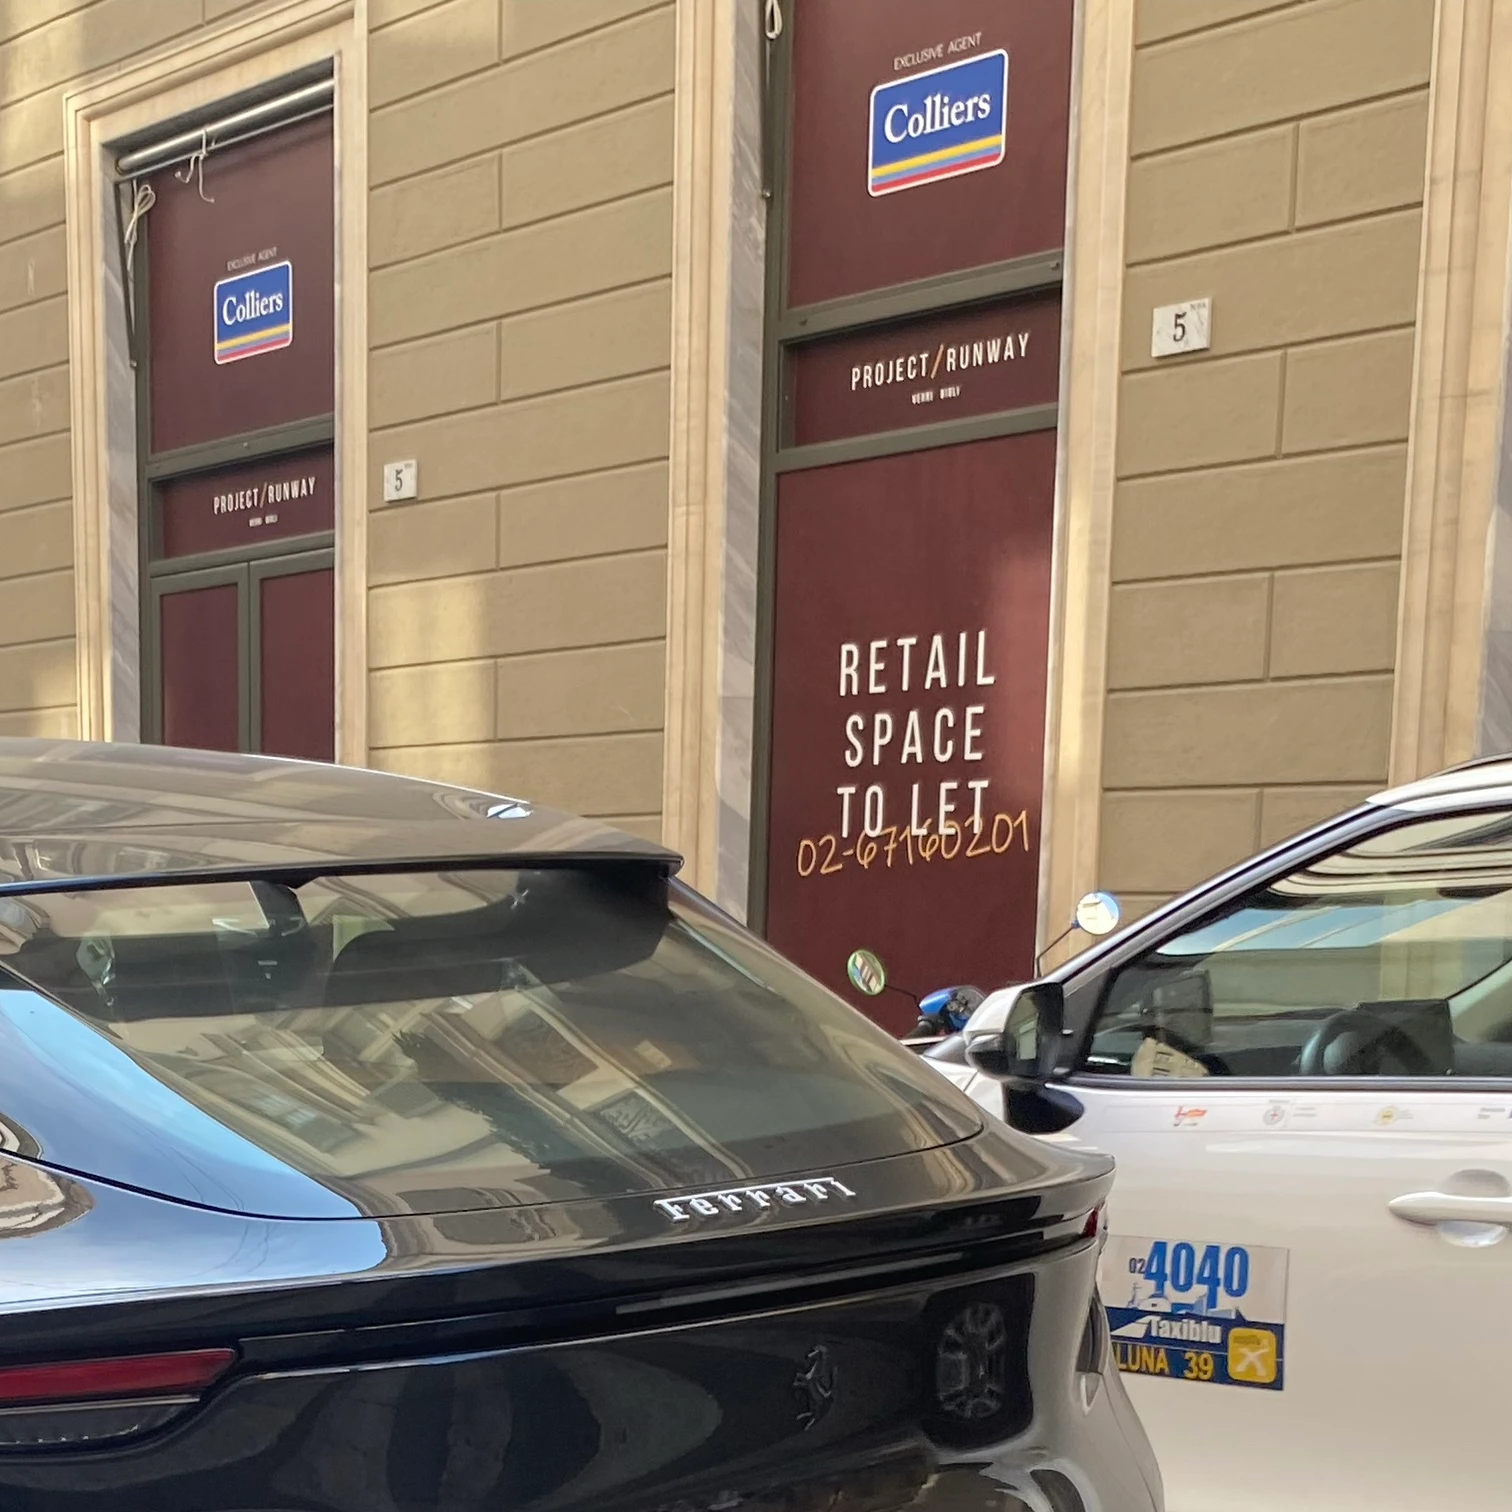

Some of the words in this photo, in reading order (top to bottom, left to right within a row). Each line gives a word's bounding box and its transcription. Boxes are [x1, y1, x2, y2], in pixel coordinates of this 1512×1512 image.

[894, 44, 943, 70] EXCLUSIVE
[948, 32, 982, 54] AGENT
[884, 93, 991, 143] Colliers
[222, 289, 284, 325] Colliers
[1173, 311, 1187, 342] 5
[851, 332, 1030, 391] PROJECT/RUNWAY
[395, 468, 403, 492] 5
[839, 629, 996, 697] RETAIL
[844, 704, 985, 768] SPACE
[836, 784, 885, 839] TO
[911, 779, 989, 837] LET
[797, 809, 1029, 877] 02-67160201
[653, 1176, 857, 1222] Ferrari
[1129, 1258, 1146, 1274] 02
[1144, 1240, 1250, 1310] 4040
[1145, 1315, 1222, 1344] Taxiblu
[1183, 1351, 1215, 1381] 39
